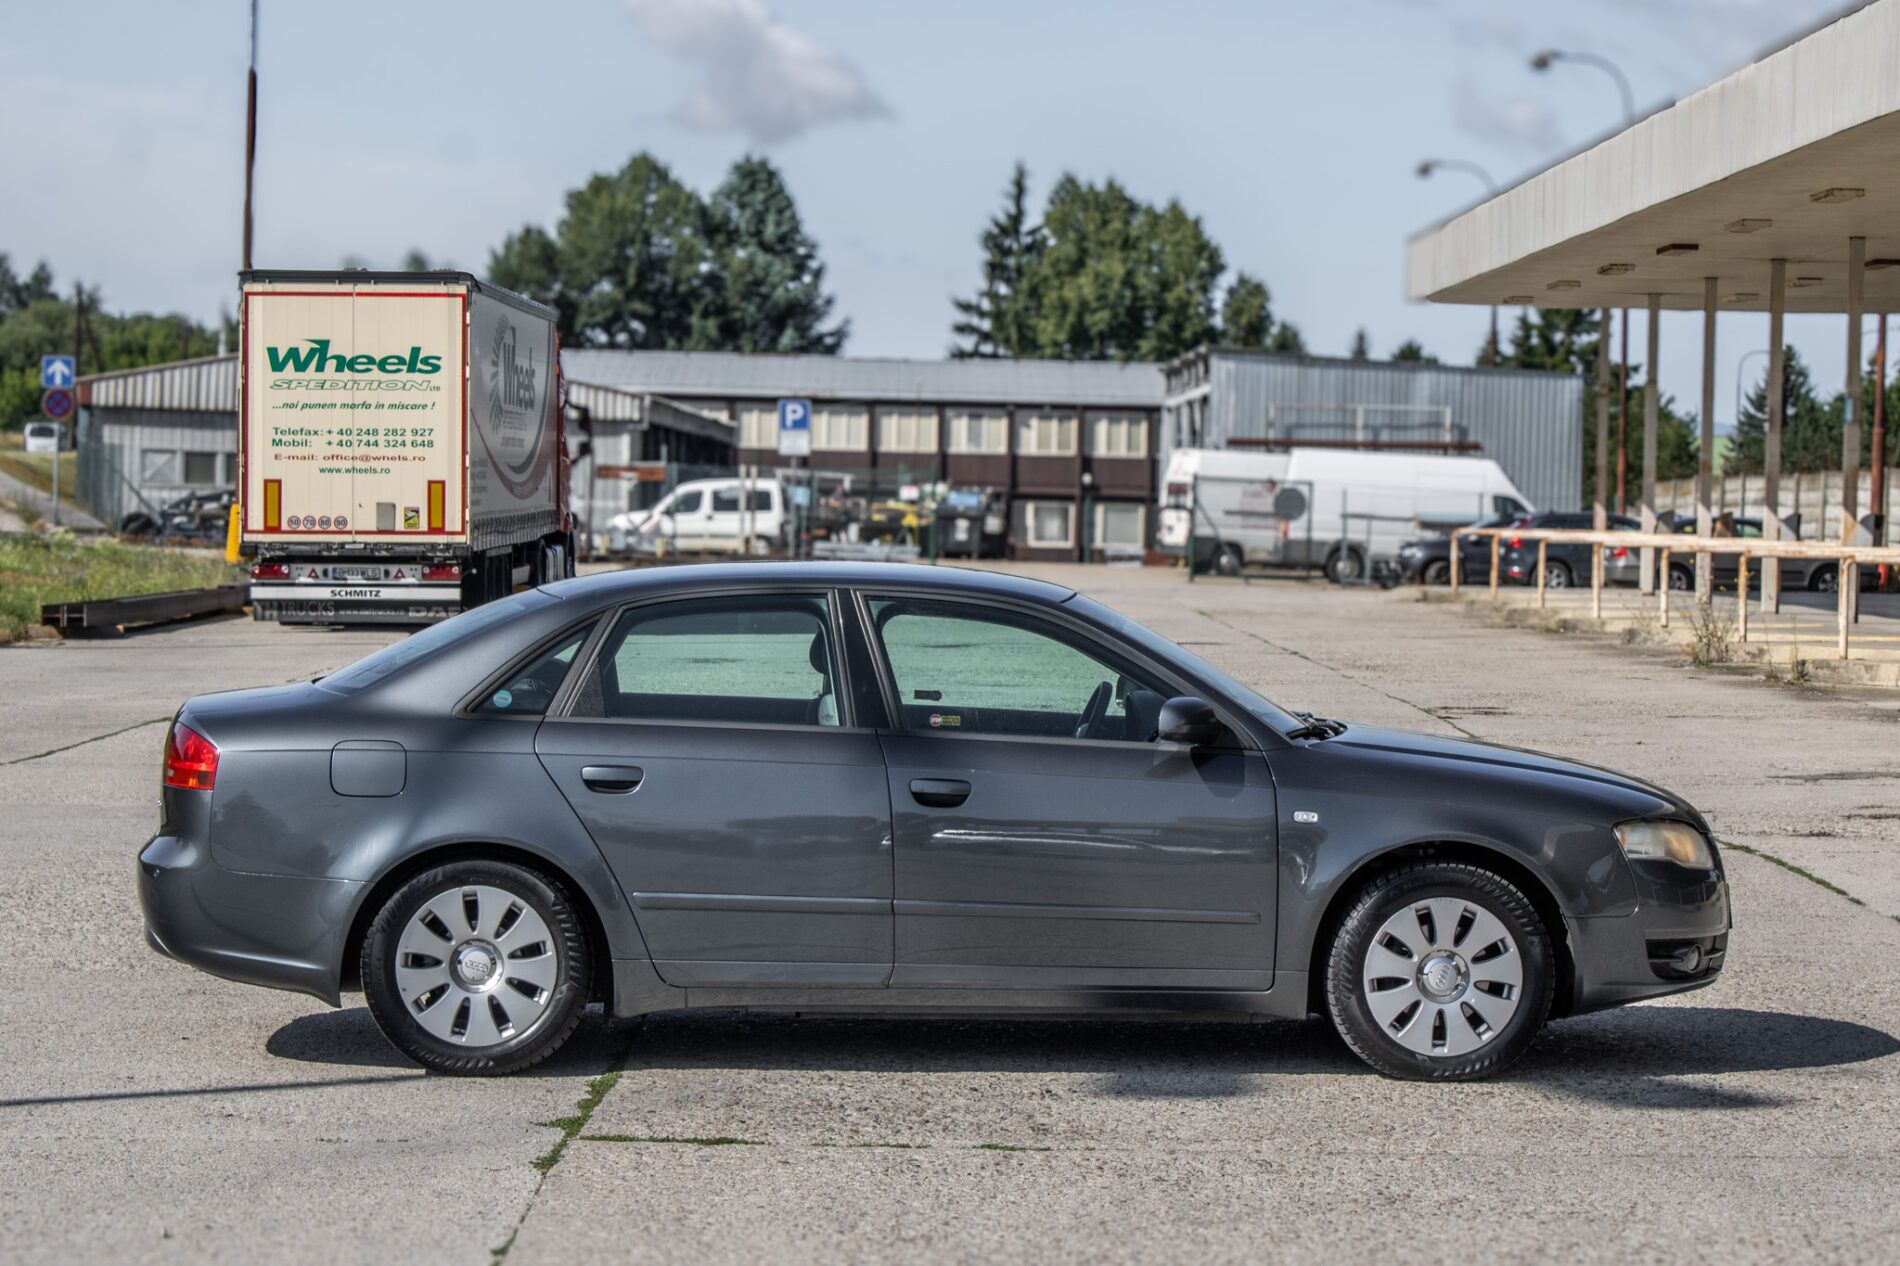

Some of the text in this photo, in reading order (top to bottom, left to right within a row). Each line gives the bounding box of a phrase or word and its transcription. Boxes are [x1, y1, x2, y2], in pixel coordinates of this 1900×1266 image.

[266, 339, 442, 374] Wheels
[270, 379, 430, 391] SPEDITION
[300, 402, 336, 411] punem
[340, 401, 372, 410] marfa
[375, 401, 385, 410] in
[387, 401, 428, 410] miscare
[785, 403, 804, 428] P
[272, 427, 324, 436] Telefax:
[356, 428, 379, 437] 248
[383, 428, 406, 437] 282
[411, 428, 434, 437] 927
[272, 438, 312, 447] Mobil:
[356, 439, 379, 448] 744
[383, 439, 406, 448] 324
[410, 439, 434, 448] 648
[274, 453, 318, 461] E-mail:
[318, 466, 391, 474] www.wheels.ro
[330, 589, 381, 598] SCHMITZ
[281, 600, 335, 616] TRUCKS
